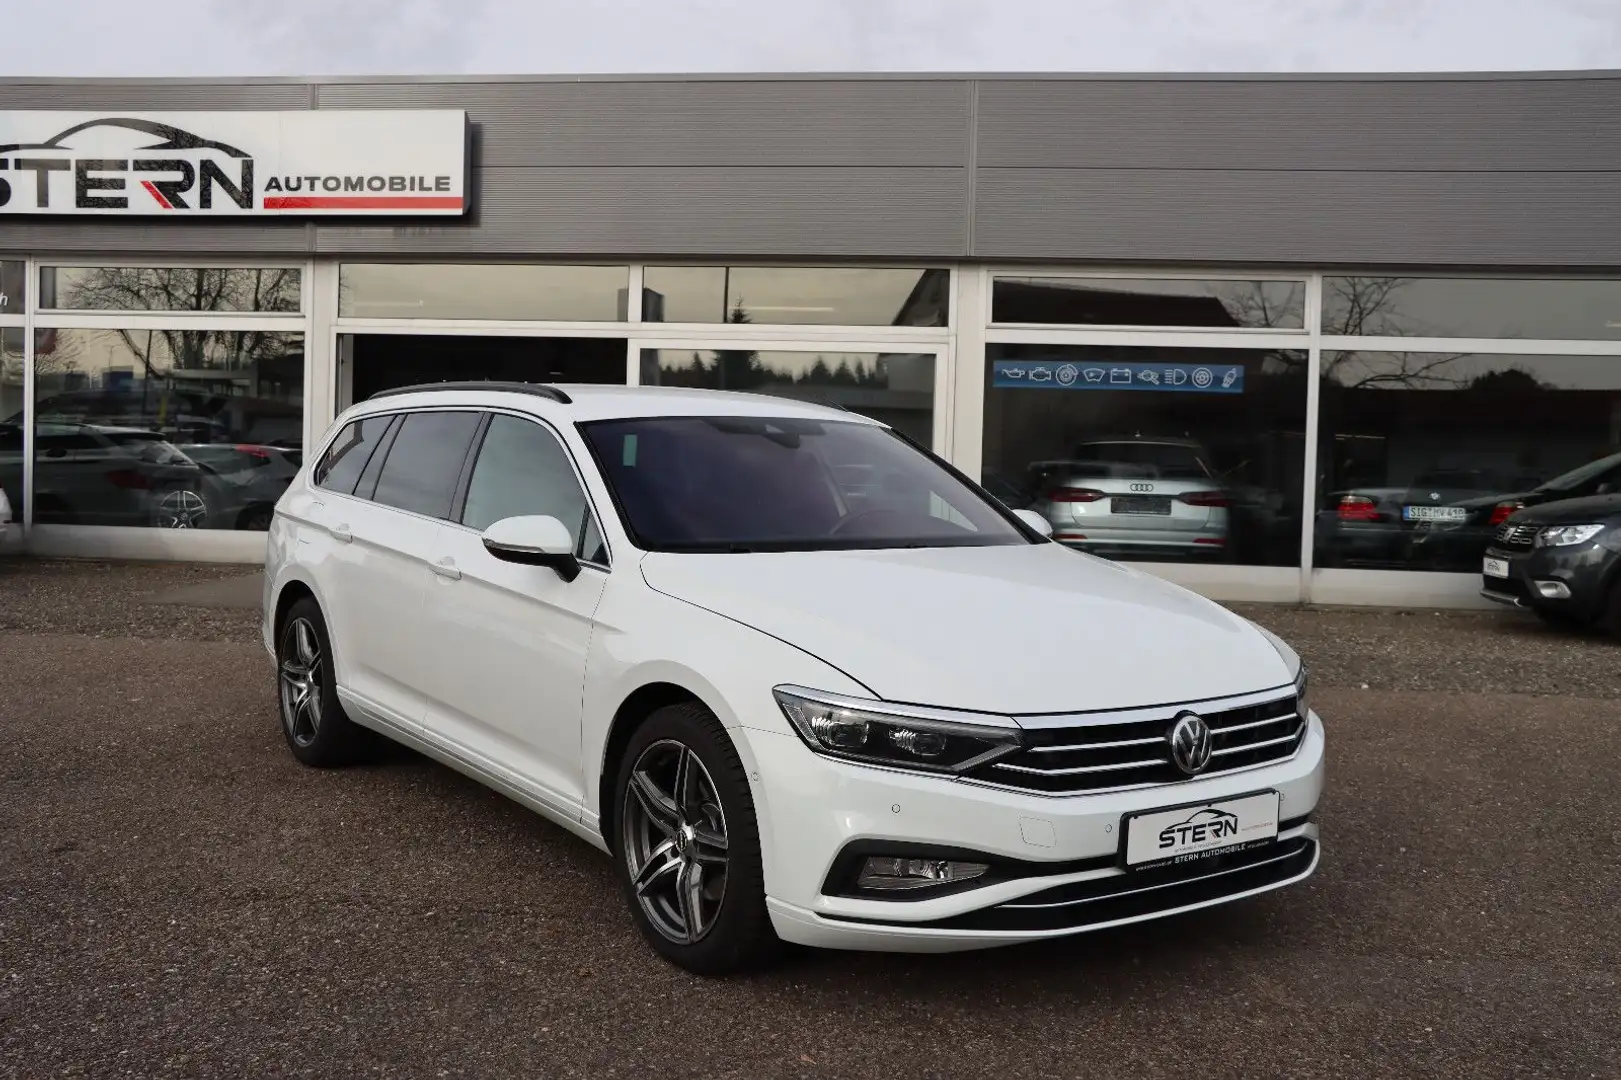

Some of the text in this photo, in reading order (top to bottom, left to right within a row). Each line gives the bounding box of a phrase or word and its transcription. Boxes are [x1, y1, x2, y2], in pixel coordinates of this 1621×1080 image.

[0, 158, 451, 209] TERN AUTOMOBILE
[1158, 817, 1239, 849] STERN
[1174, 852, 1199, 864] STERN
[1200, 843, 1246, 859] AUTOMOBILE
